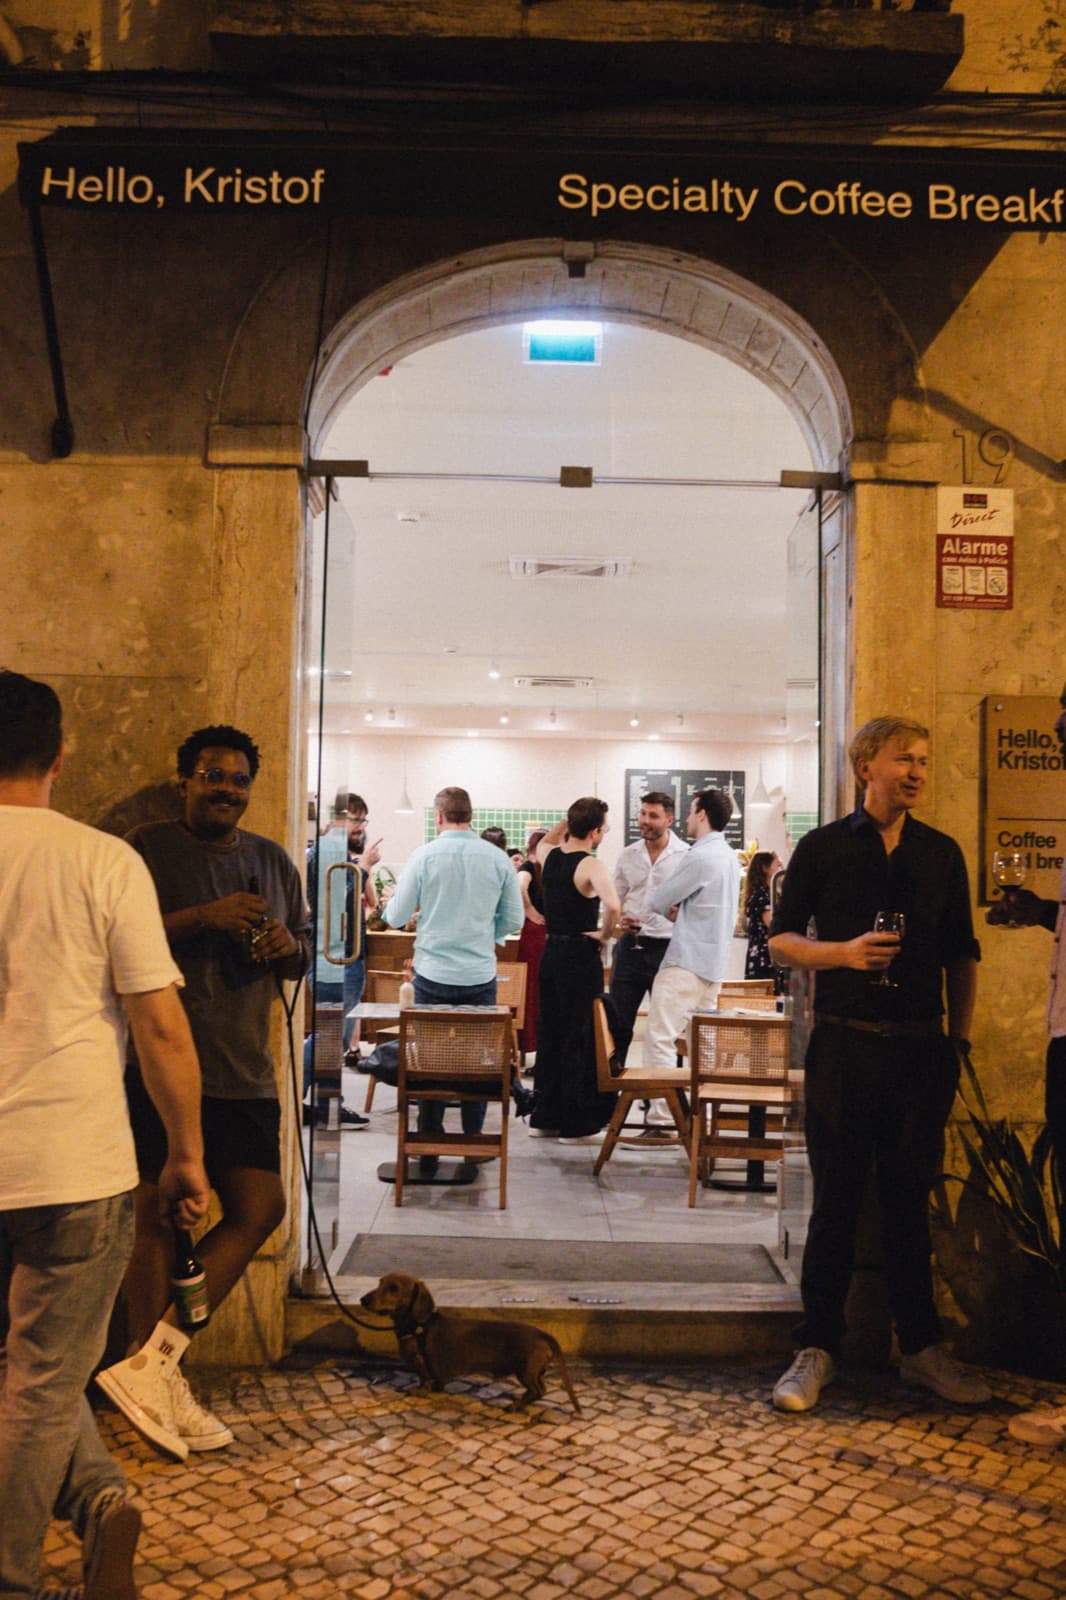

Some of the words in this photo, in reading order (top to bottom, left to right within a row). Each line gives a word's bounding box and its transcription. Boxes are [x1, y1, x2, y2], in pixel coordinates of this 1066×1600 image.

[41, 166, 165, 208] Hello,
[184, 167, 325, 204] Kristof
[557, 173, 759, 222] Specialty
[774, 180, 913, 218] Coffee
[928, 184, 1065, 222] Breakf
[953, 428, 1013, 484] 19
[942, 537, 1008, 556] Alarme
[997, 728, 1057, 753] Hello,
[997, 830, 1057, 849] Coffee
